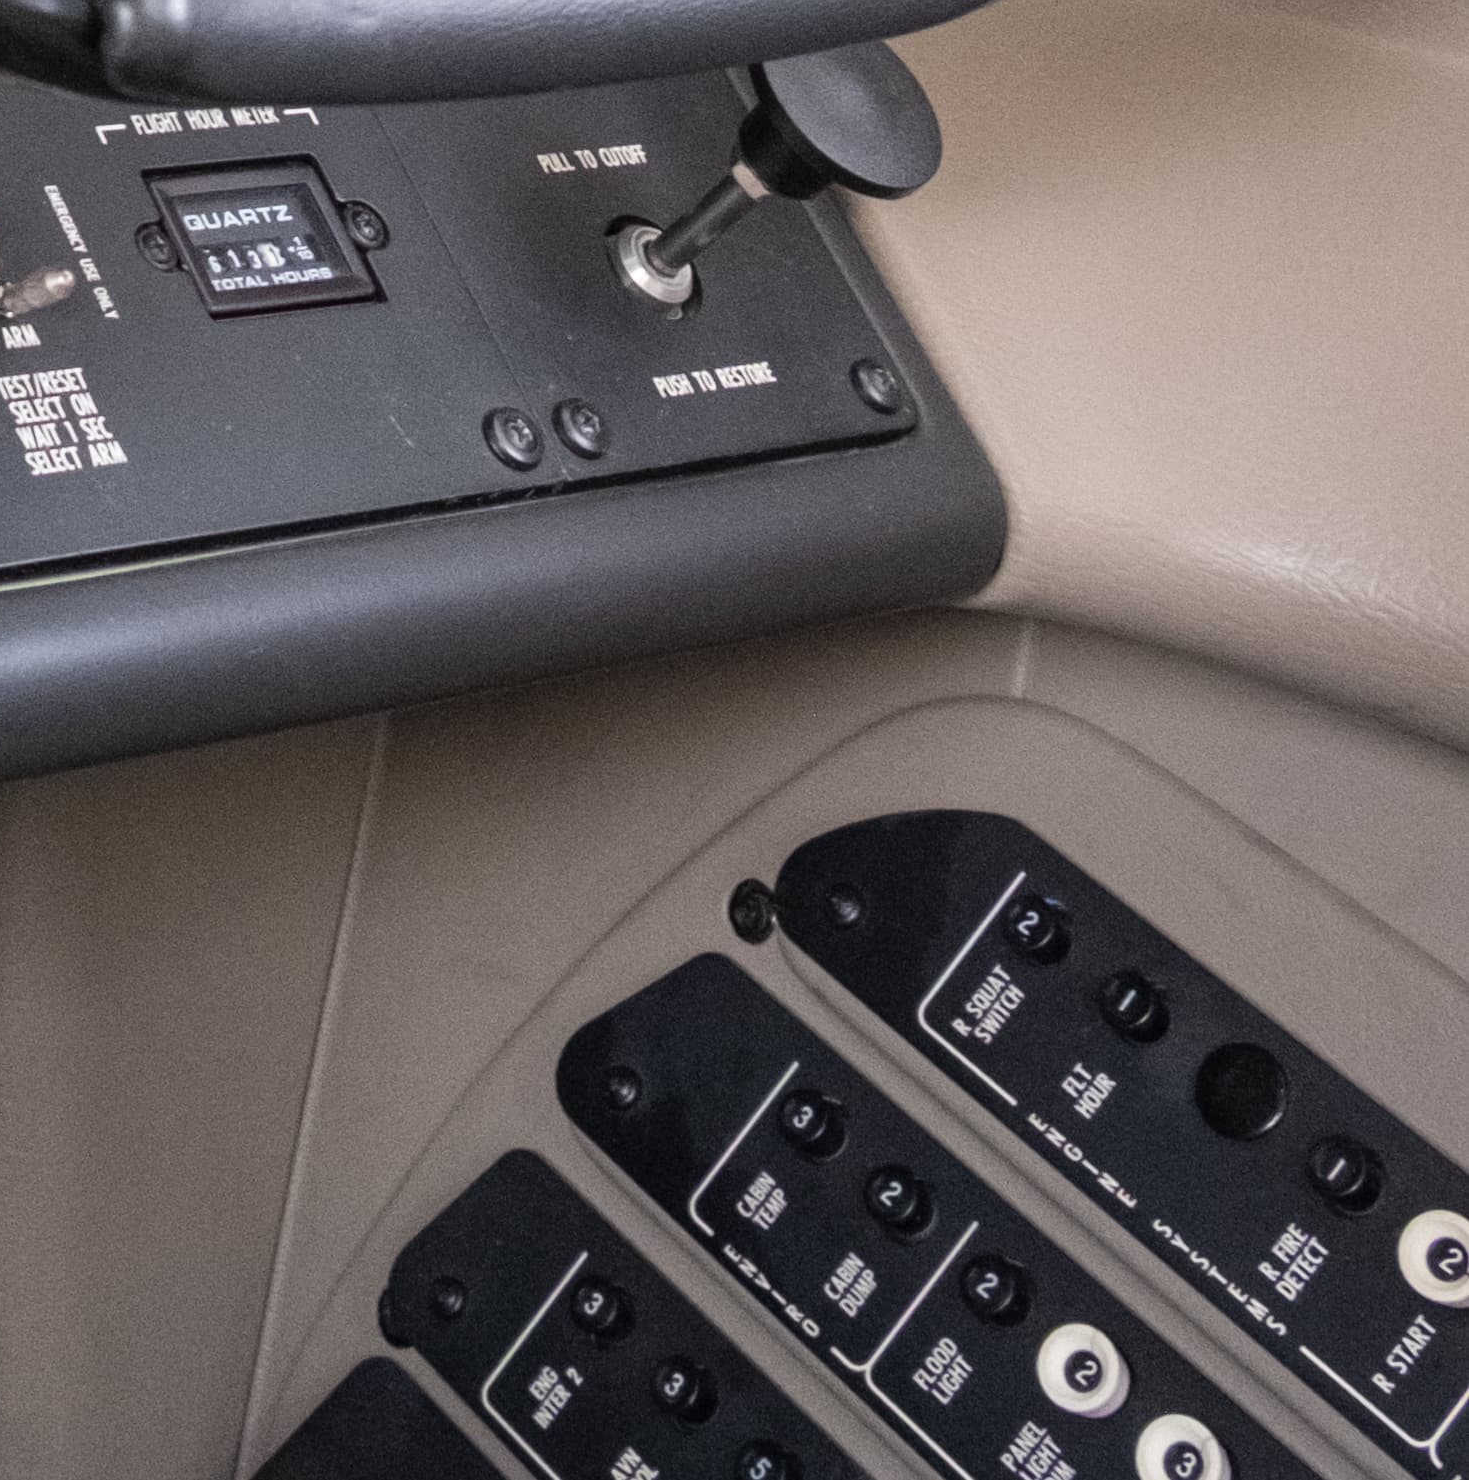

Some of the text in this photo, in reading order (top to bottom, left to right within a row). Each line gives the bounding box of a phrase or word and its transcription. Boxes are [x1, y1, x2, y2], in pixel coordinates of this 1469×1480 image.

[130, 111, 182, 135] FLIGHT
[184, 108, 229, 130] HOUR
[537, 144, 647, 174] PULL TO CUTOFF
[183, 204, 293, 231] QUARTZ
[44, 185, 120, 319] EMERGENCY USE ONLY
[1, 324, 41, 349] ARM
[652, 361, 777, 398] PUSH TO RESTORE
[9, 394, 98, 425] SELECT ON
[15, 417, 113, 450] WAIT 1 SEC
[25, 442, 128, 476] SELECT ARM
[952, 965, 1011, 1037] R SQUAT
[975, 984, 1025, 1044] SWITCH
[1062, 1062, 1094, 1098] FLT
[1075, 1072, 1117, 1119] HOUR
[736, 1171, 777, 1219] CABIN
[753, 1187, 790, 1230] TEMP
[1028, 1112, 1287, 1336] ENGINE SYSTEMS
[1258, 1222, 1308, 1282] R FIRE
[1276, 1237, 1330, 1301] DETECT
[824, 1252, 865, 1301] CABIN
[839, 1269, 878, 1318] DUMP
[912, 1337, 959, 1392] FLOOD
[1371, 1315, 1437, 1394] R START
[530, 1365, 559, 1401] ENG
[533, 1367, 583, 1430] INTER 2
[932, 1354, 973, 1405] LIGHT
[1000, 1421, 1048, 1471] PANEL
